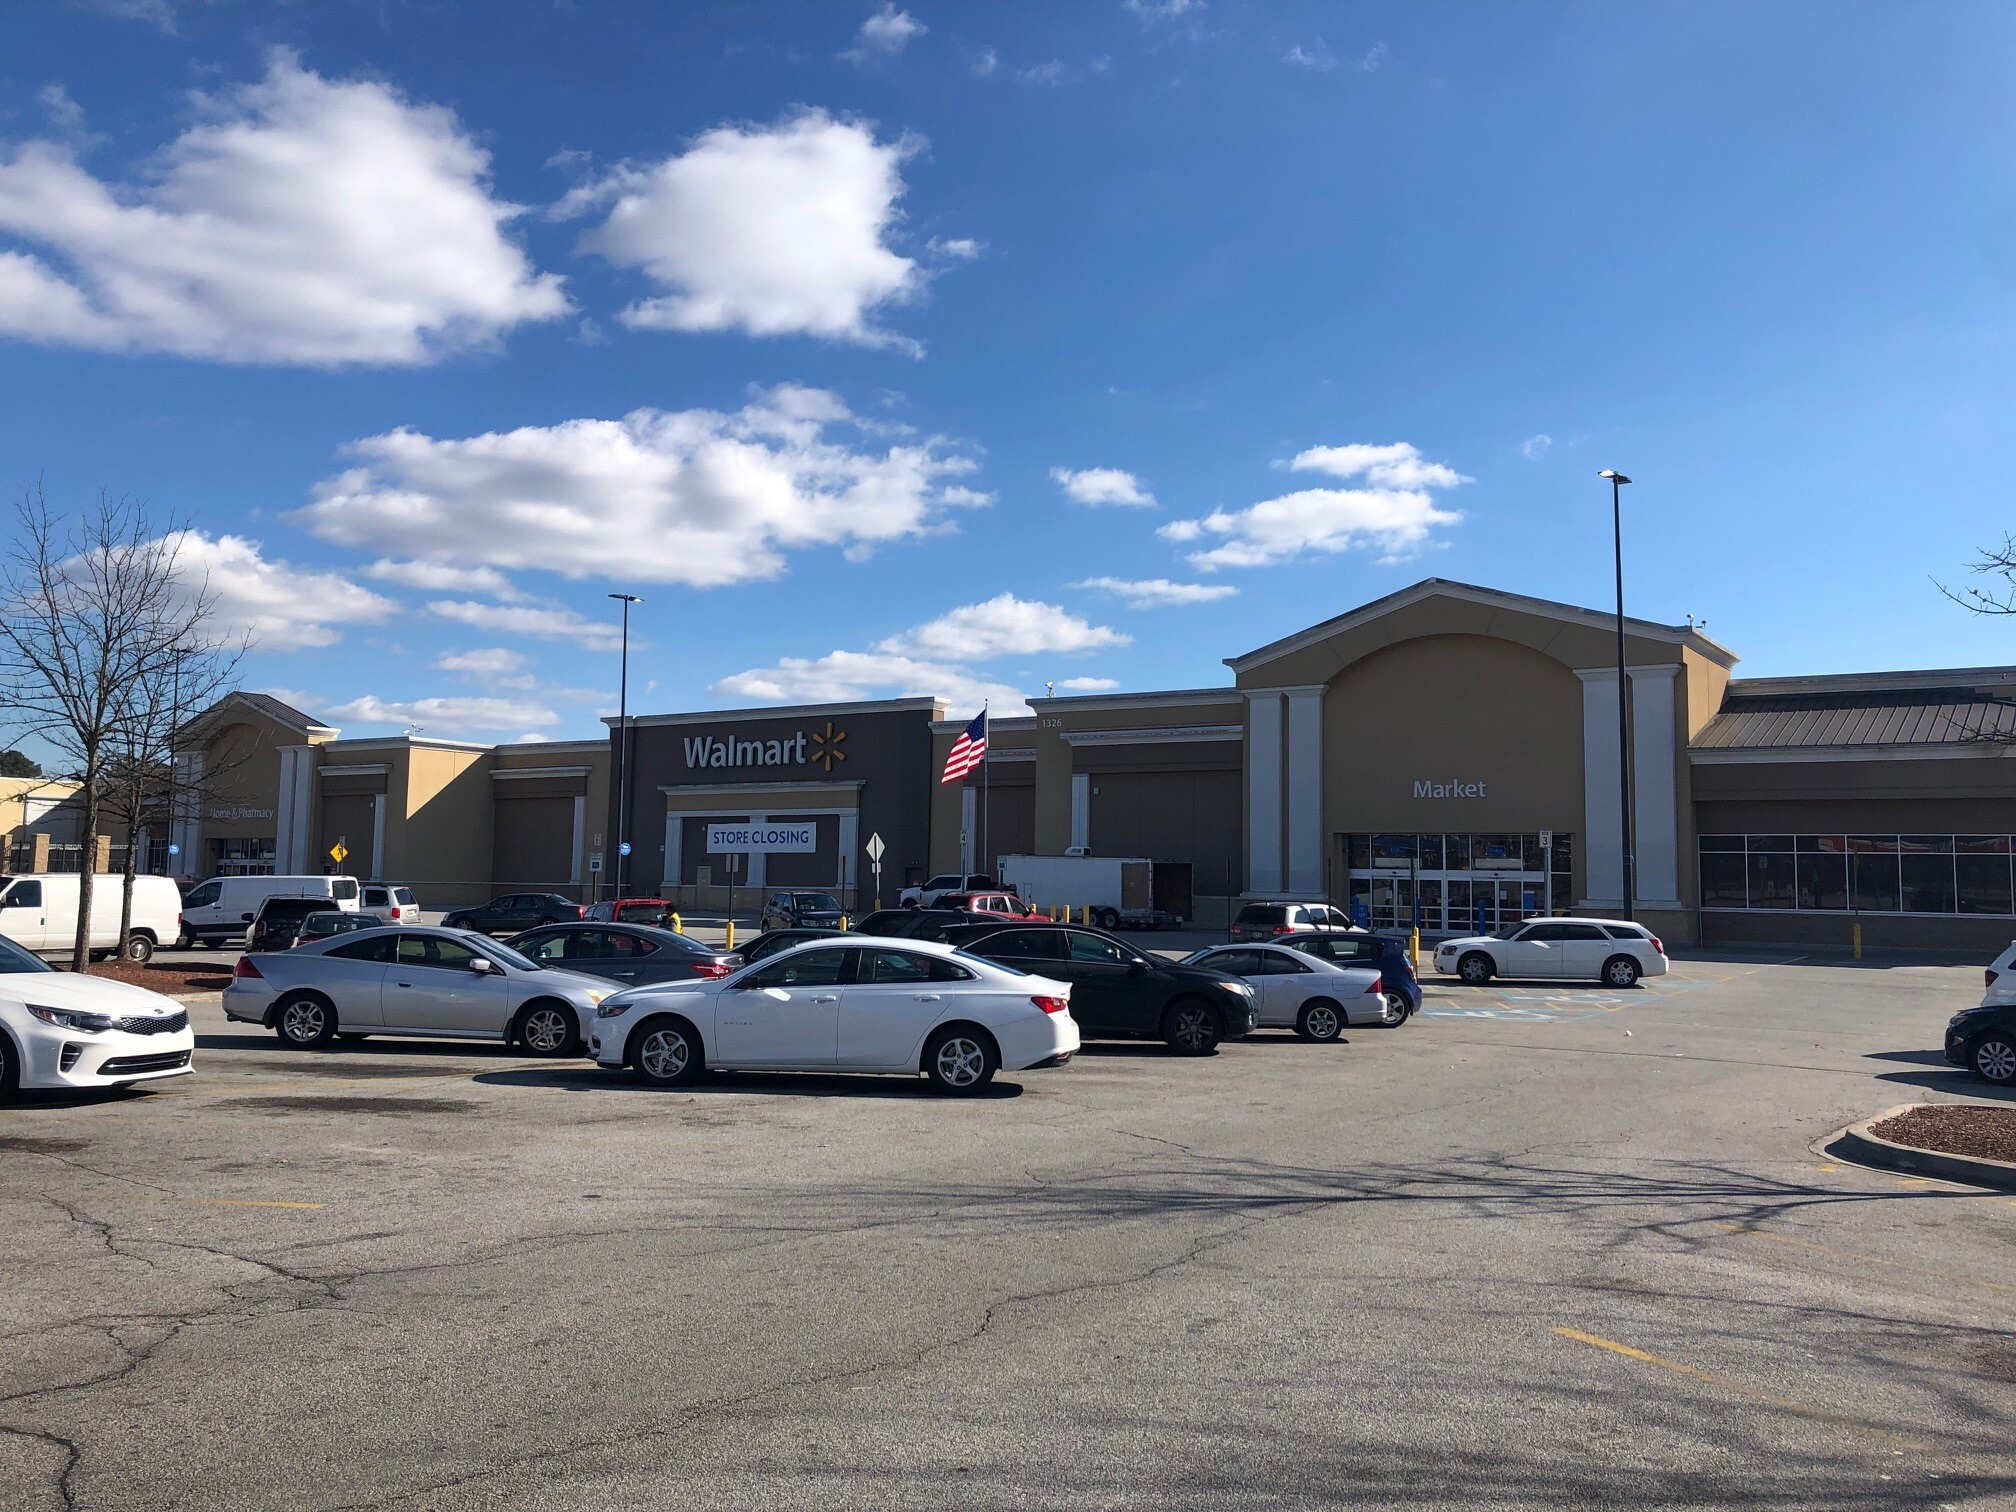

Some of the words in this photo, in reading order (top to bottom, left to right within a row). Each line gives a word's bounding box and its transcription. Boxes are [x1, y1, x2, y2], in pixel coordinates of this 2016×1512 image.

[1041, 718, 1062, 728] 1326
[683, 730, 808, 769] Walmart
[1413, 778, 1487, 798] Market
[209, 807, 231, 819] Home
[239, 806, 274, 821] Pharmacy
[713, 831, 749, 844] STORE
[751, 830, 809, 844] CLOSING
[1542, 836, 1548, 846] 3
